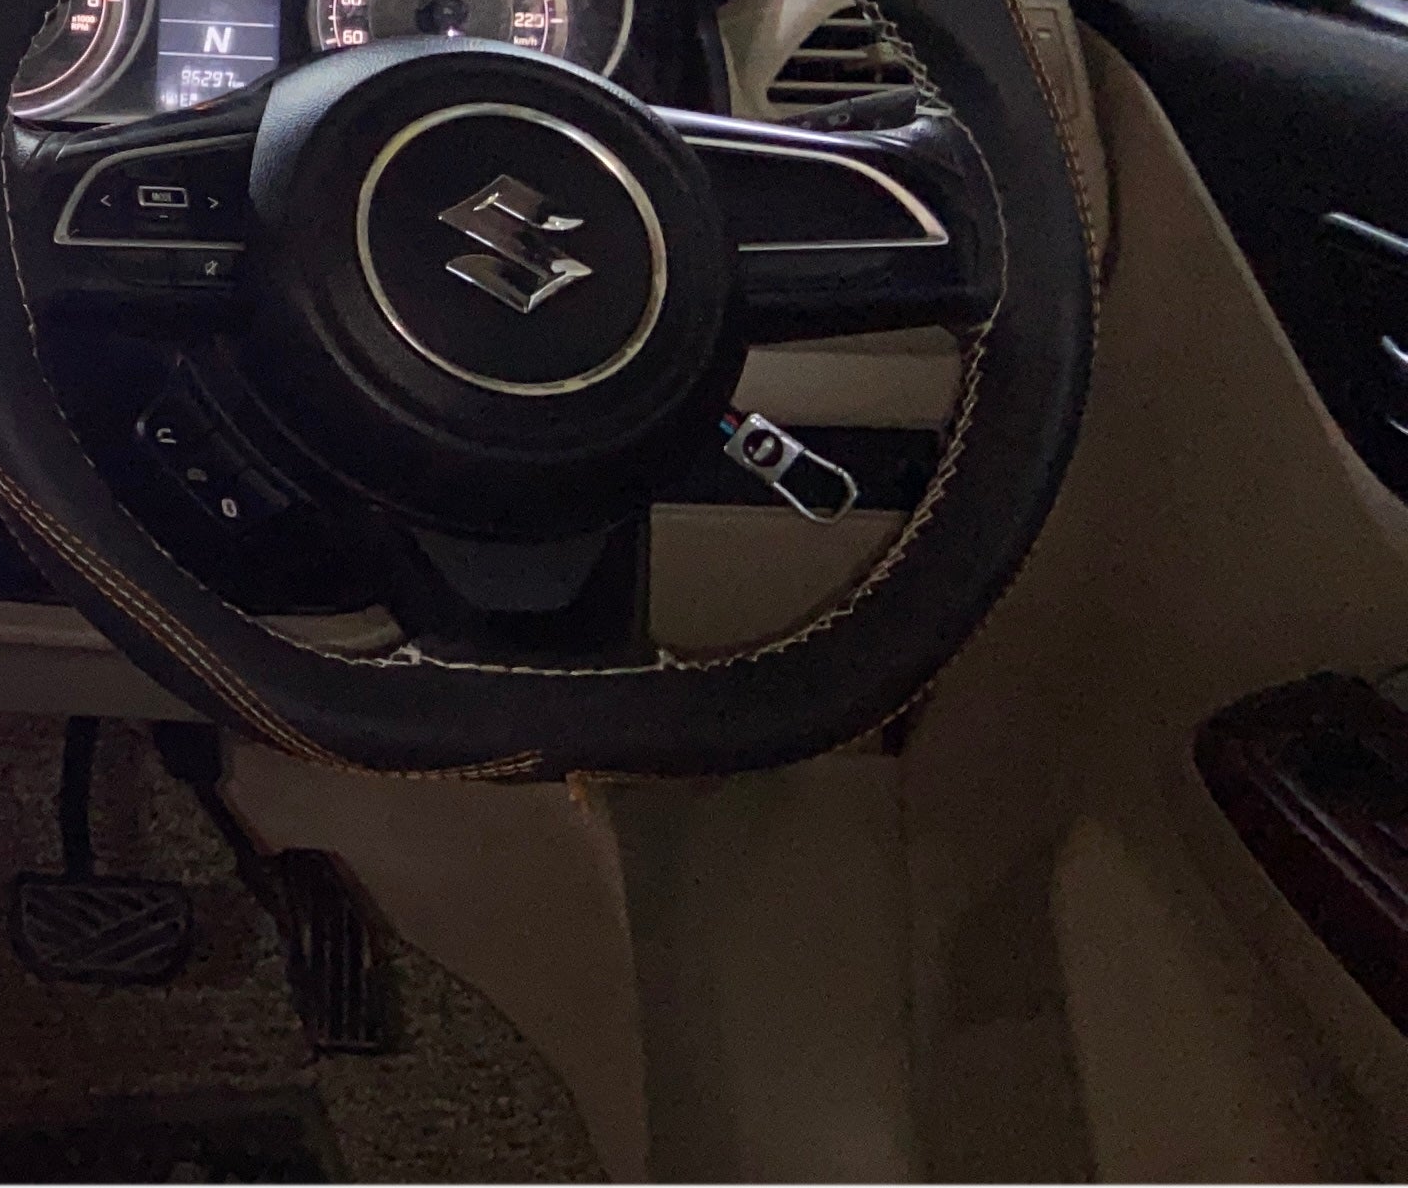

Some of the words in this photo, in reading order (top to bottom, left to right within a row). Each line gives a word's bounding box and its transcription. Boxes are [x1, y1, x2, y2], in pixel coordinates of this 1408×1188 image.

[514, 12, 544, 28] 220
[203, 26, 232, 53] N
[342, 30, 363, 45] 60
[513, 36, 538, 46] km/h
